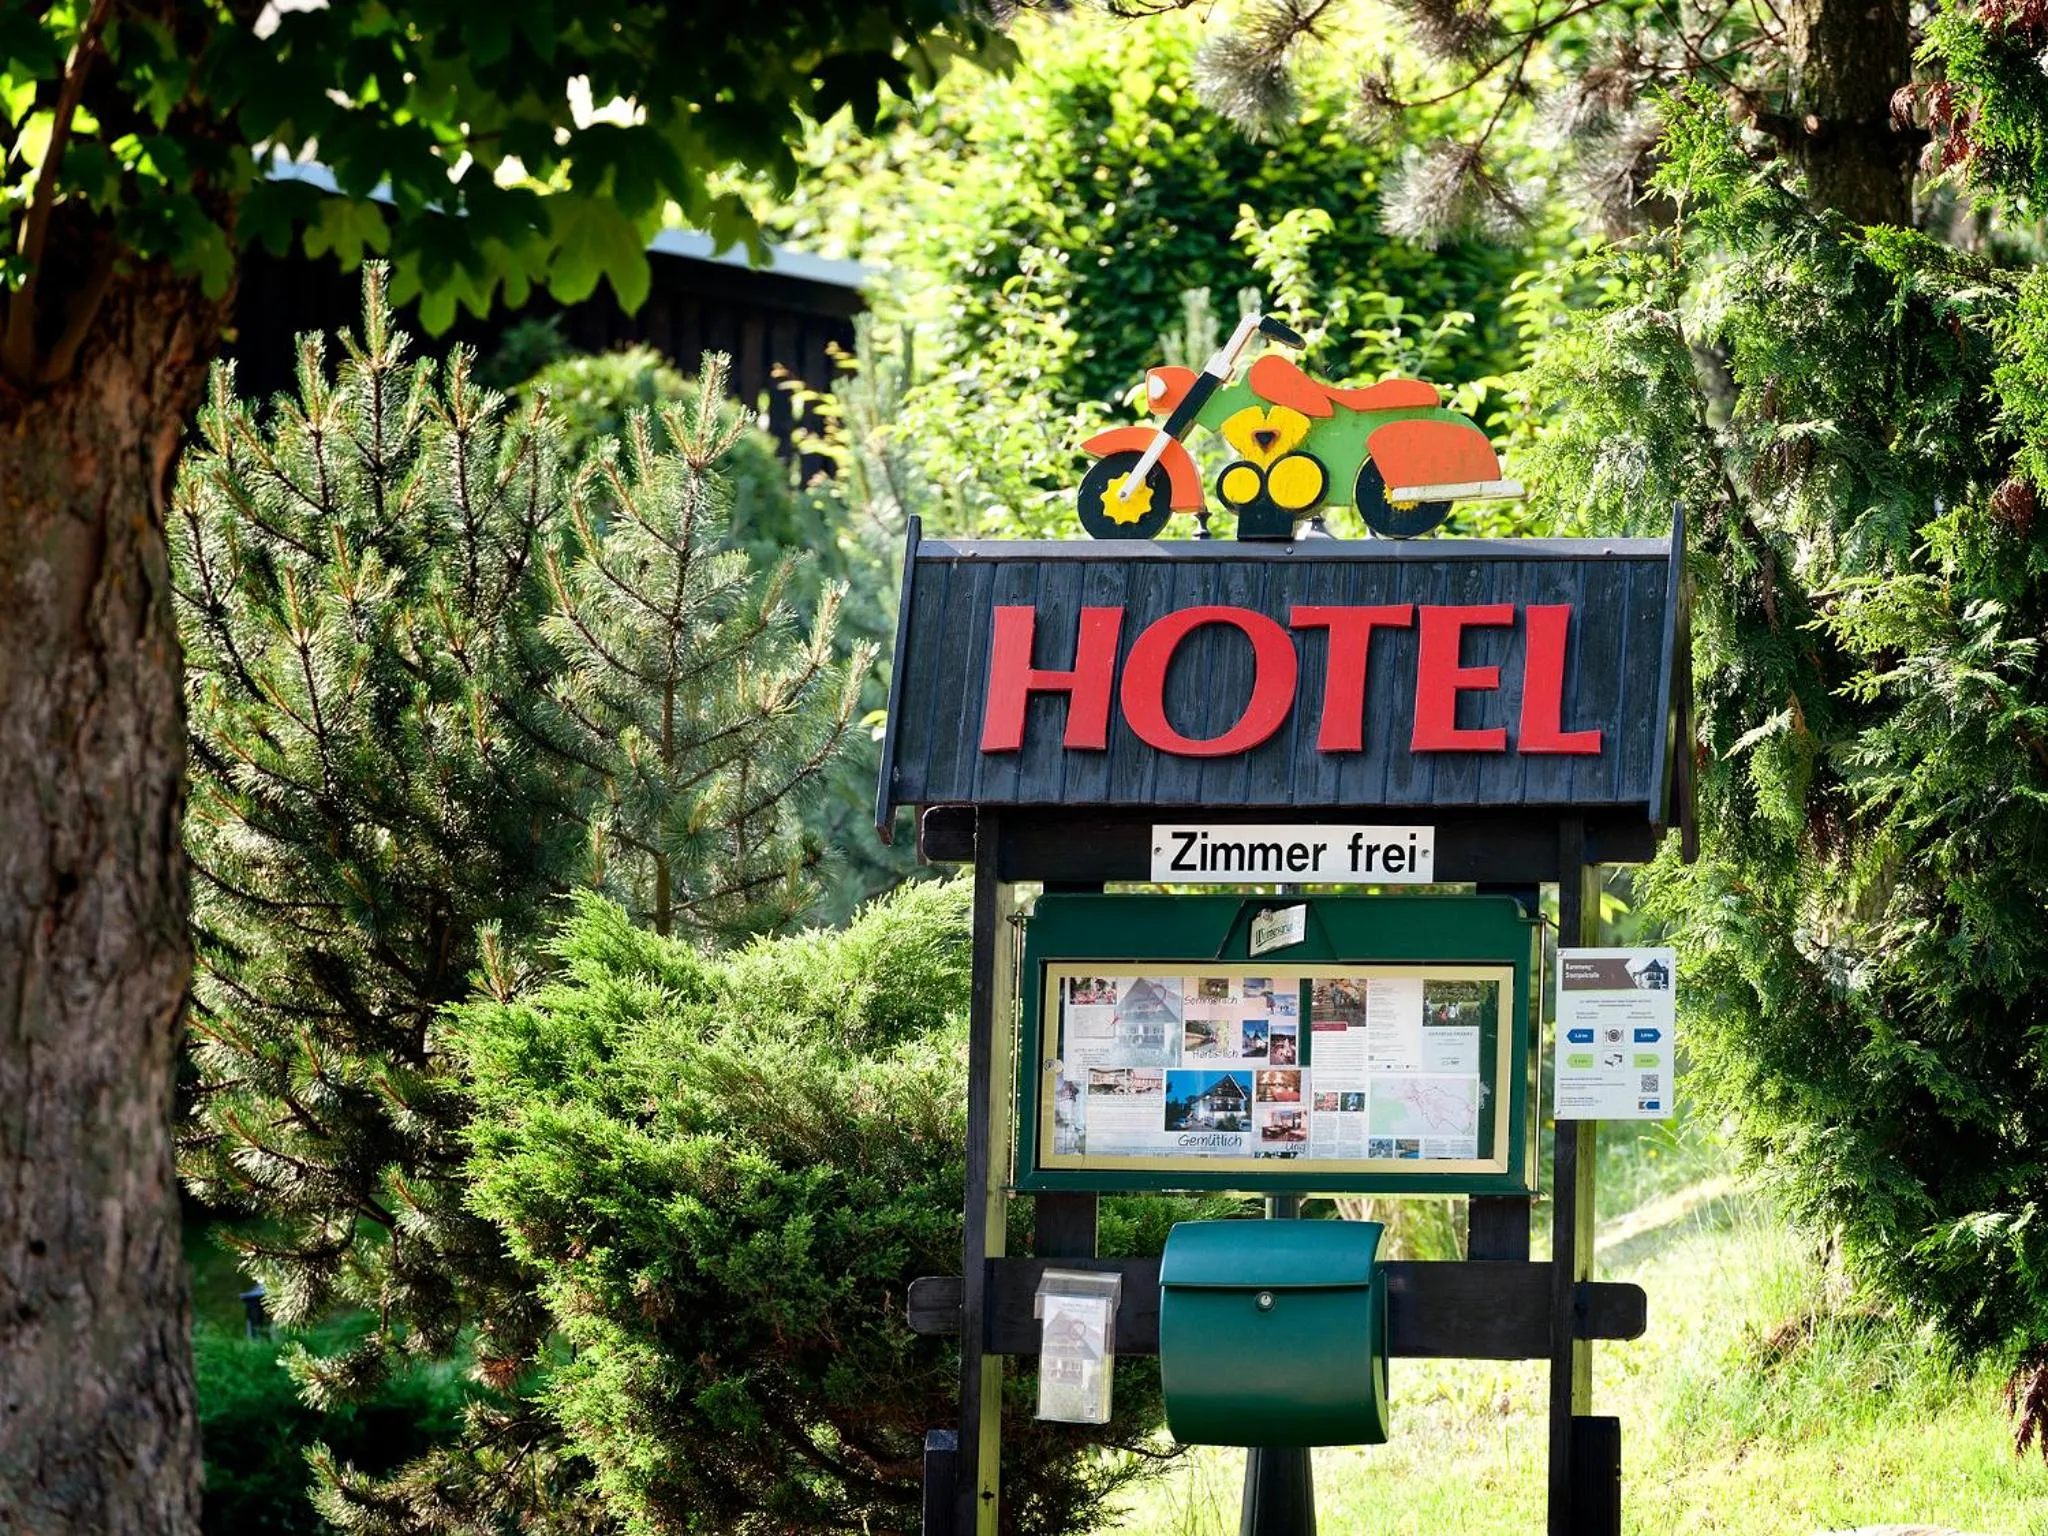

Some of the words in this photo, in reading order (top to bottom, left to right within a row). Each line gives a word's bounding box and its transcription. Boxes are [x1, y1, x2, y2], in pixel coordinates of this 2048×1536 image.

[979, 603, 1602, 757] HOTEL
[1170, 831, 1327, 872] Zimmer
[1347, 832, 1417, 873] frei
[1177, 1133, 1243, 1148] Gemütlich
